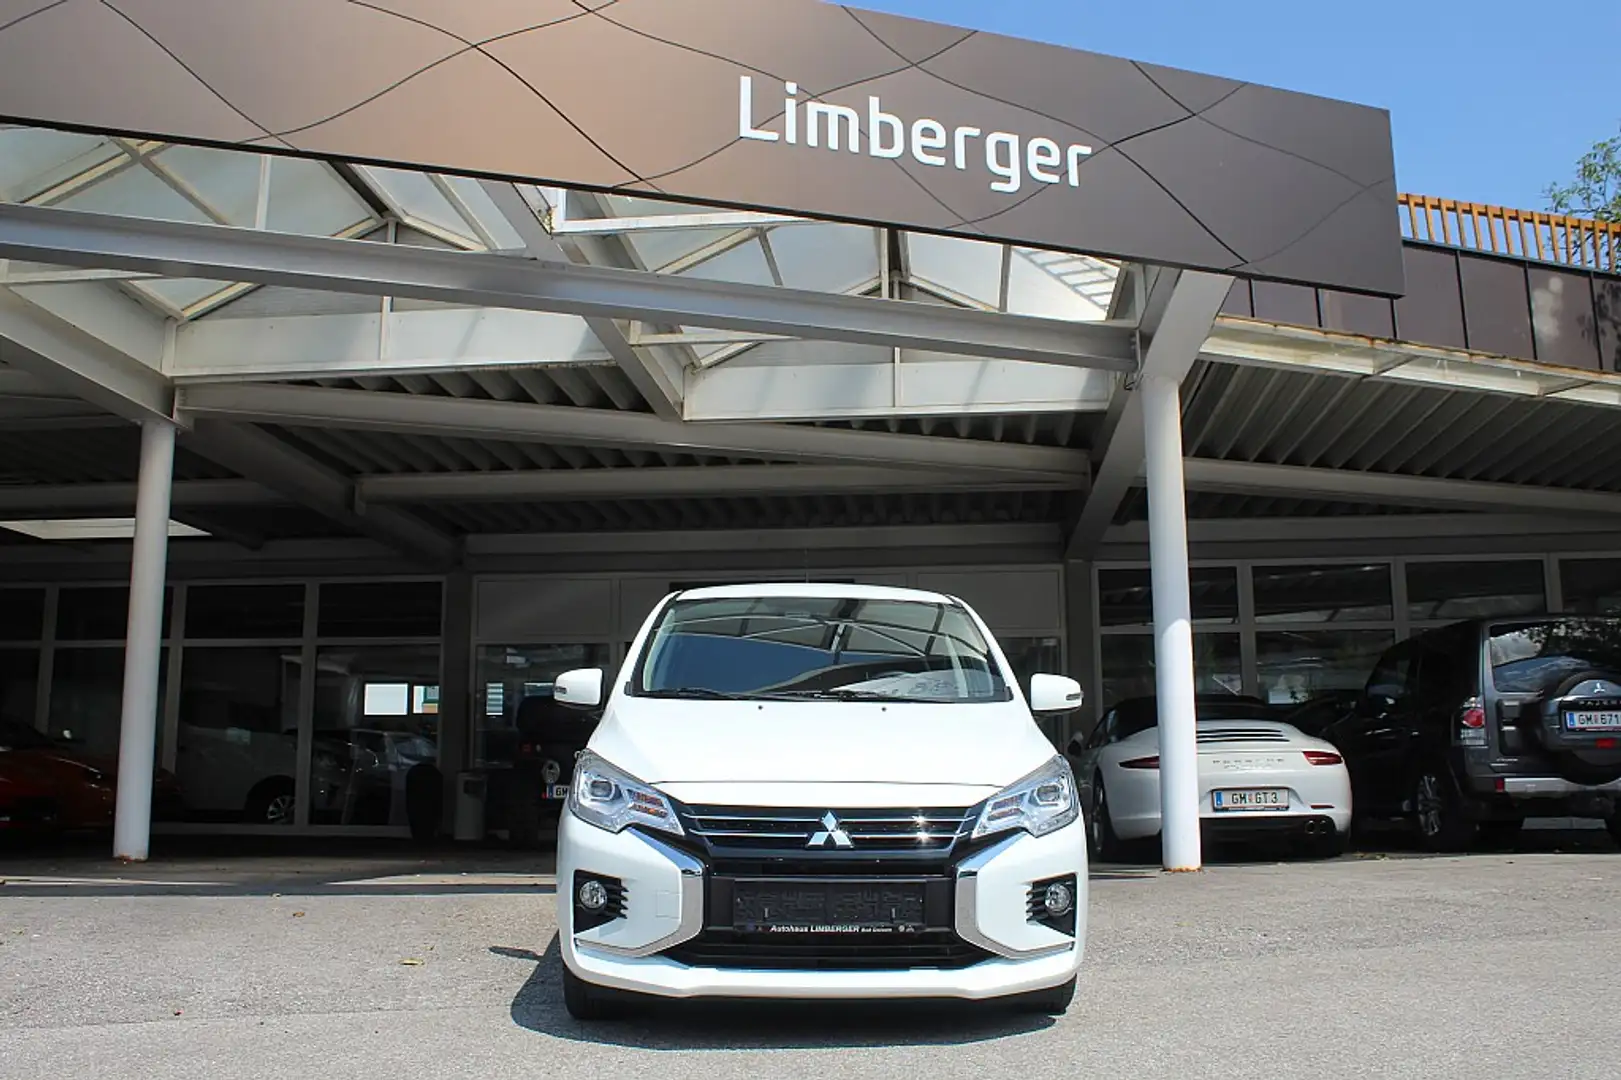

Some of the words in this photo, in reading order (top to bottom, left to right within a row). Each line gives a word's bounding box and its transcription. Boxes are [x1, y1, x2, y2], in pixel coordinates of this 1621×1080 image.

[739, 75, 1093, 194] Limberger
[1578, 713, 1594, 725] GM
[1231, 793, 1247, 804] GM
[1255, 792, 1278, 804] GT3
[769, 924, 809, 933] Autohaus
[810, 924, 859, 933] LIMBERGER
